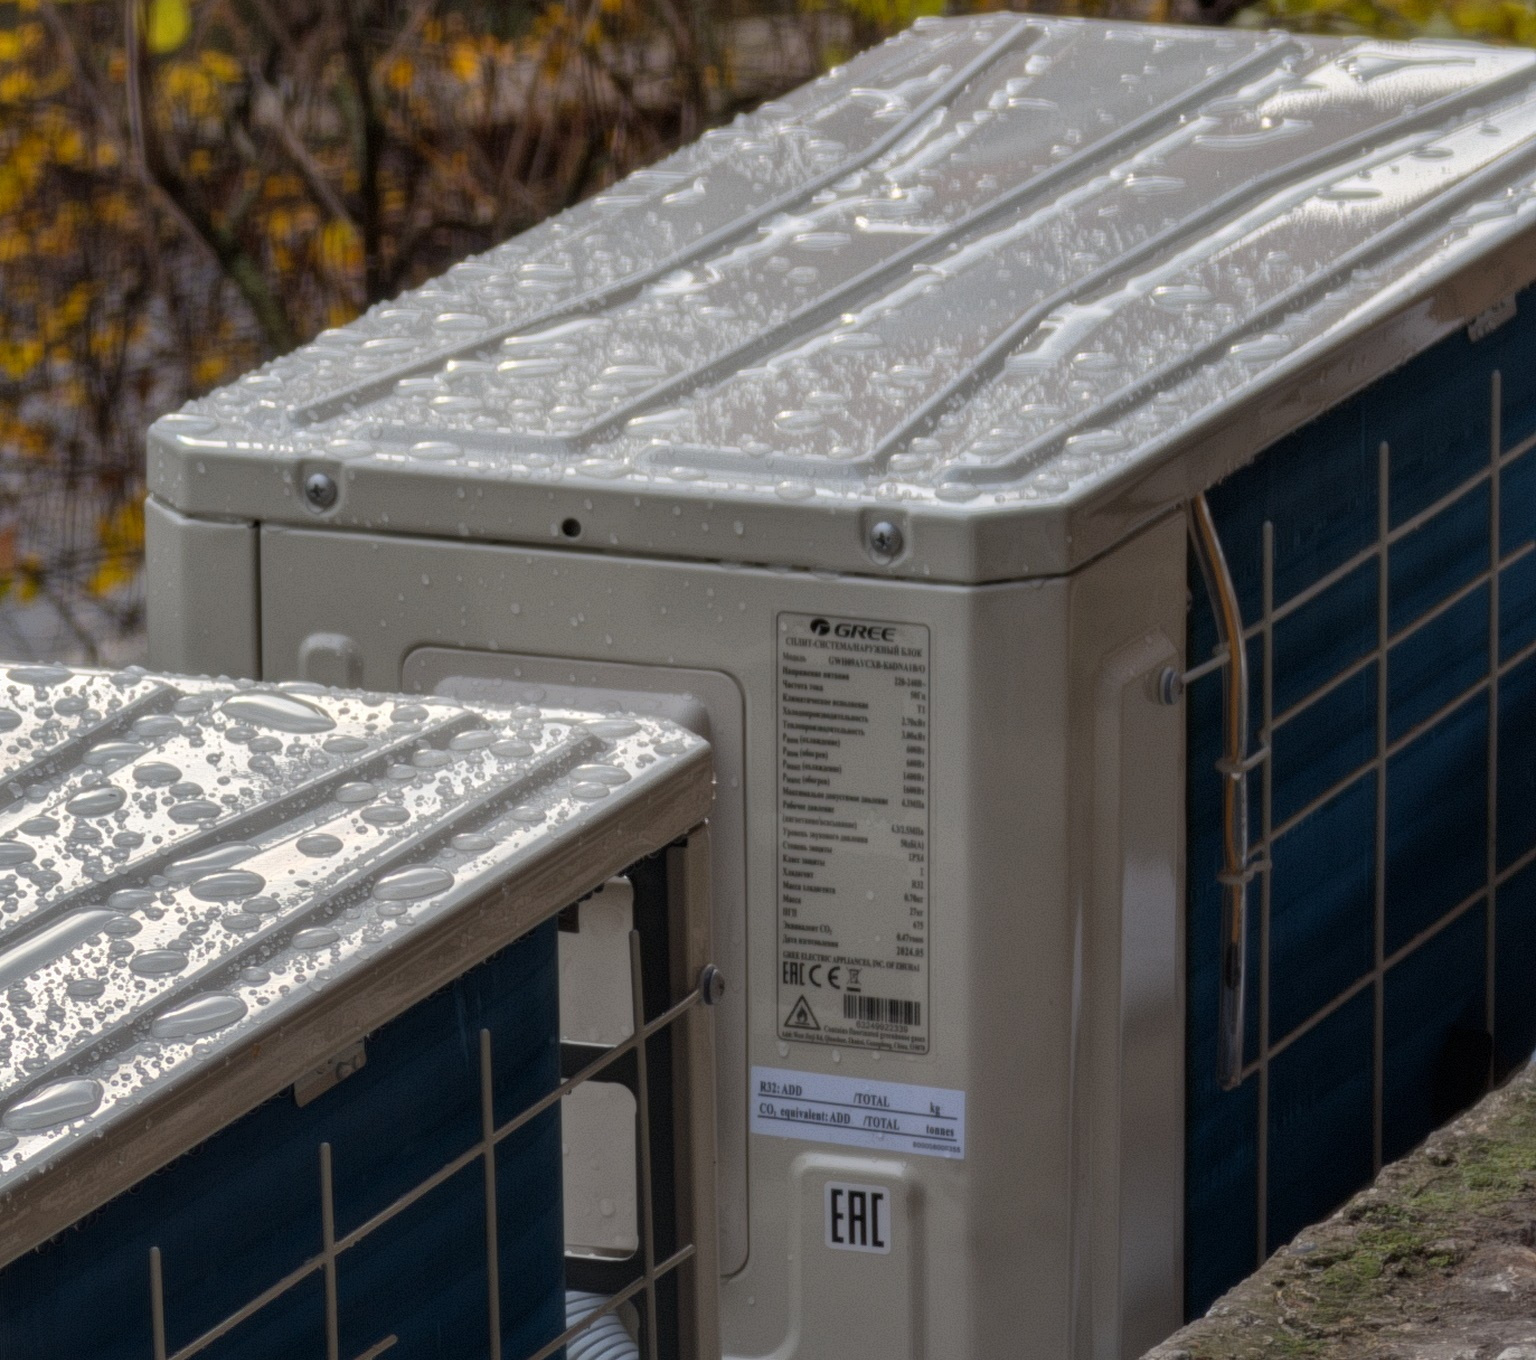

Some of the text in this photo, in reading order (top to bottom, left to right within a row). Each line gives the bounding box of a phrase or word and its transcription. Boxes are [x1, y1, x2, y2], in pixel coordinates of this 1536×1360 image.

[834, 623, 896, 642] GREE
[783, 960, 805, 985] EAC
[760, 1081, 941, 1116] R32: ADD /TOTAL kg
[780, 1108, 828, 1121] equivalent:
[830, 1111, 851, 1124] ADD
[863, 1116, 900, 1130] /TOTAL
[926, 1124, 954, 1137] tonnes
[831, 1189, 884, 1247] EAC
